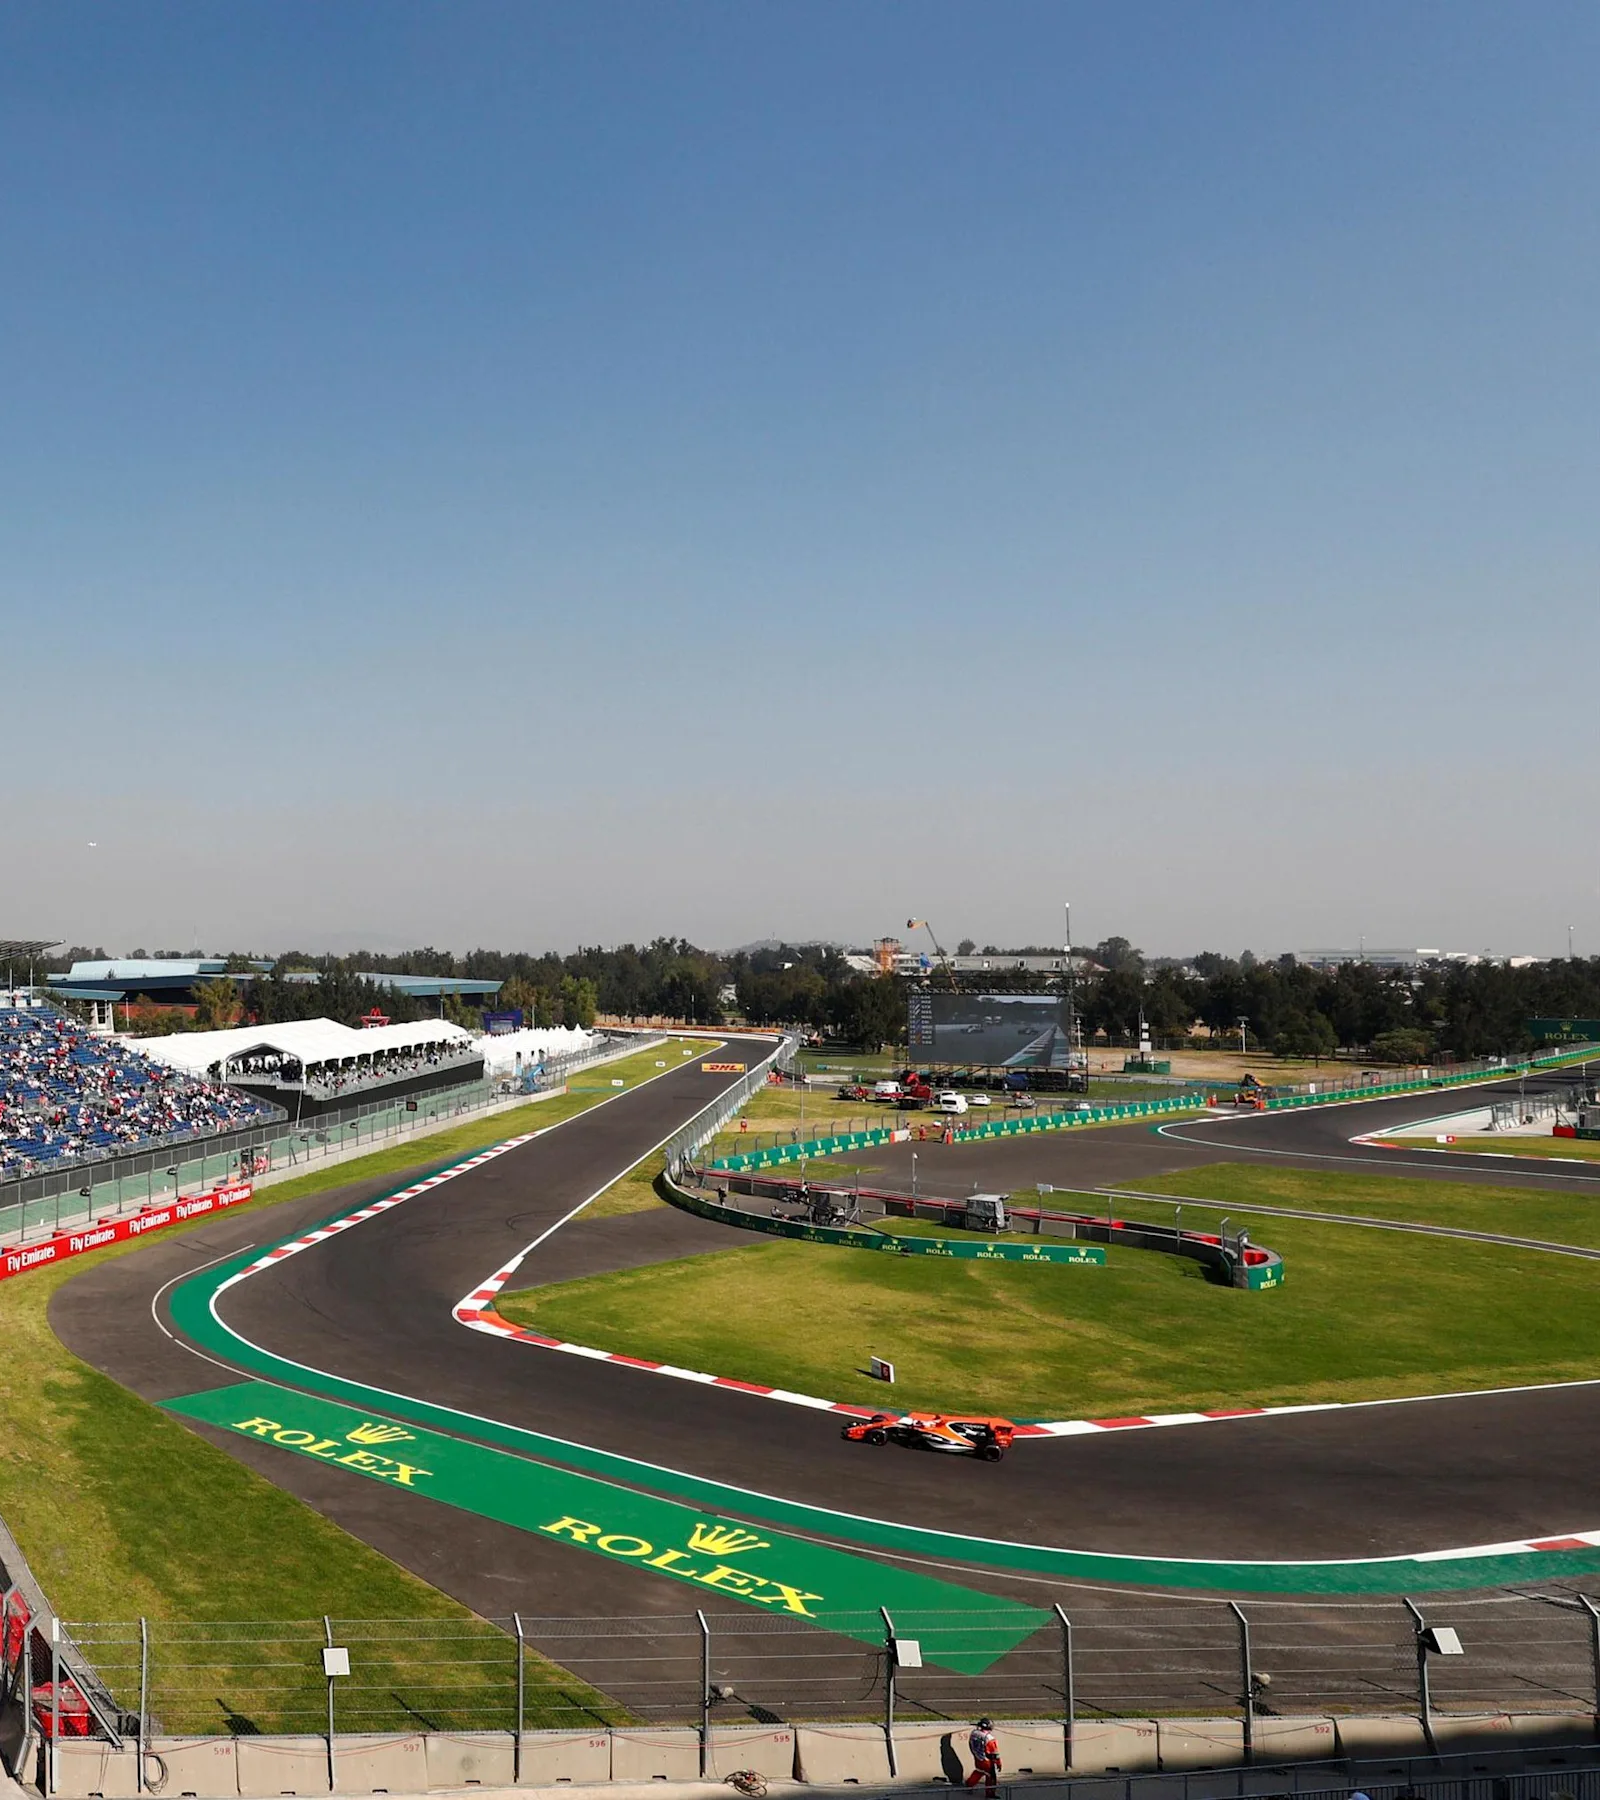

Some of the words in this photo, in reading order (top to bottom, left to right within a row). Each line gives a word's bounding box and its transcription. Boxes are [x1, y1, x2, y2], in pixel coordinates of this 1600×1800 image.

[1544, 1032, 1591, 1041] ROLEX
[176, 1205, 188, 1219] Fly
[187, 1199, 213, 1215] Emirates
[129, 1220, 141, 1234] Fly
[141, 1211, 171, 1230] Emirates
[70, 1237, 84, 1252] Fly
[84, 1229, 116, 1248] Emirates
[925, 1248, 954, 1256] ROLEX
[976, 1251, 1005, 1259] ROLEX
[7, 1255, 21, 1272] Fly
[21, 1246, 56, 1267] Emirates
[1022, 1253, 1051, 1261] ROLEX
[1068, 1256, 1097, 1264] ROLEX
[232, 1416, 433, 1486] ROLEX
[539, 1516, 824, 1618] ROLEX
[1314, 1726, 1331, 1734] 592
[773, 1735, 791, 1743] 595
[403, 1743, 420, 1752] 597
[589, 1740, 606, 1748] 596
[213, 1747, 232, 1756] 598
